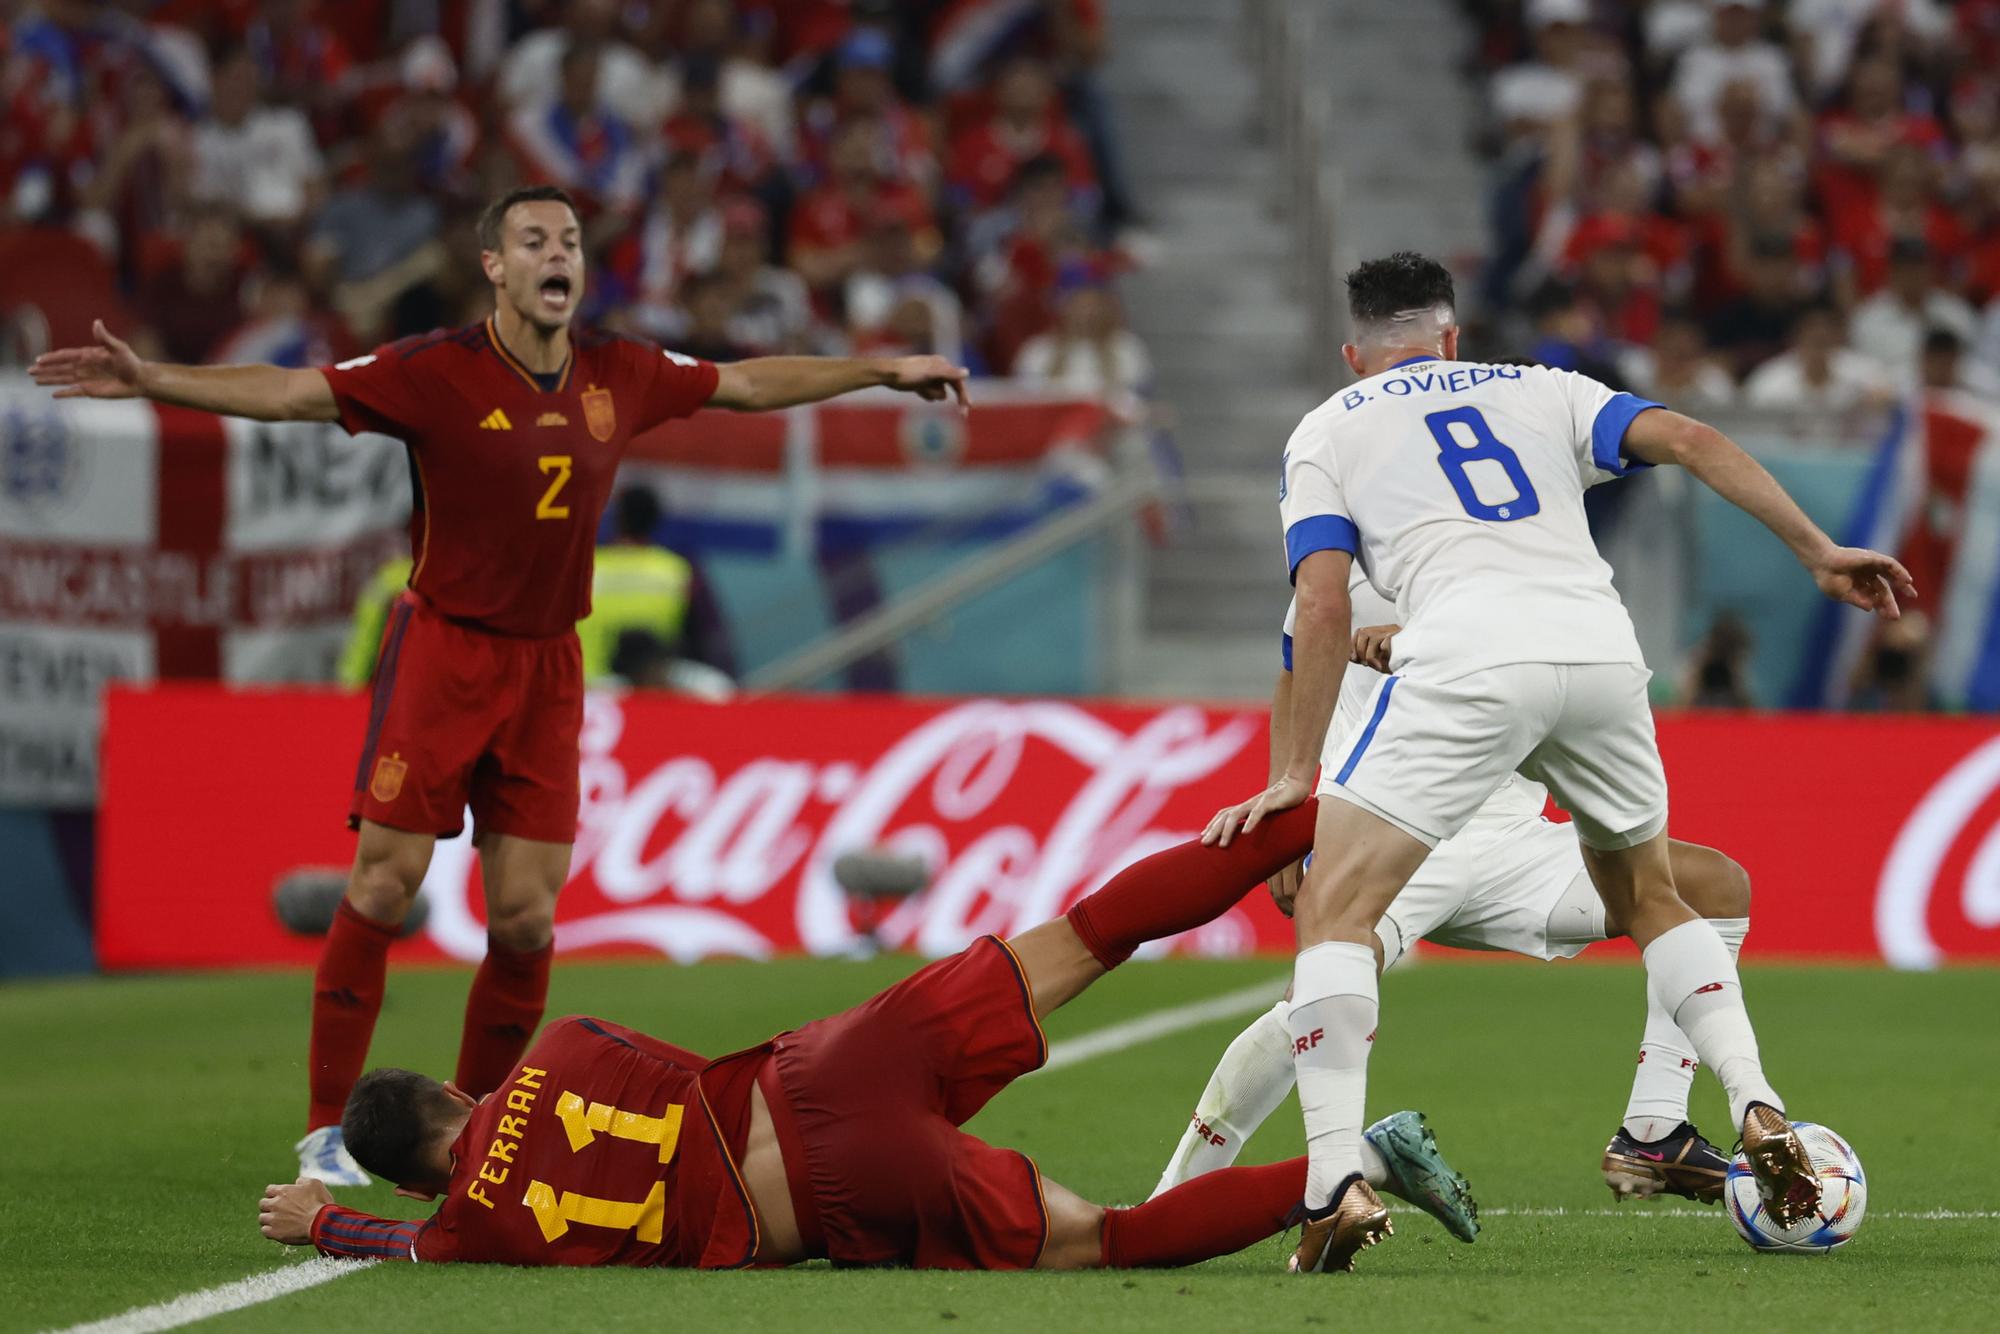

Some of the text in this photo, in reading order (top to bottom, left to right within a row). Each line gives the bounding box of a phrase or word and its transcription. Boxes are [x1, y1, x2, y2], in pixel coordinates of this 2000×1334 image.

[1342, 368, 1521, 411] B. OVIEDO
[536, 455, 572, 519] 2
[1424, 405, 1540, 521] 8
[467, 1065, 547, 1209] FERRAN
[522, 1090, 685, 1244] 11
